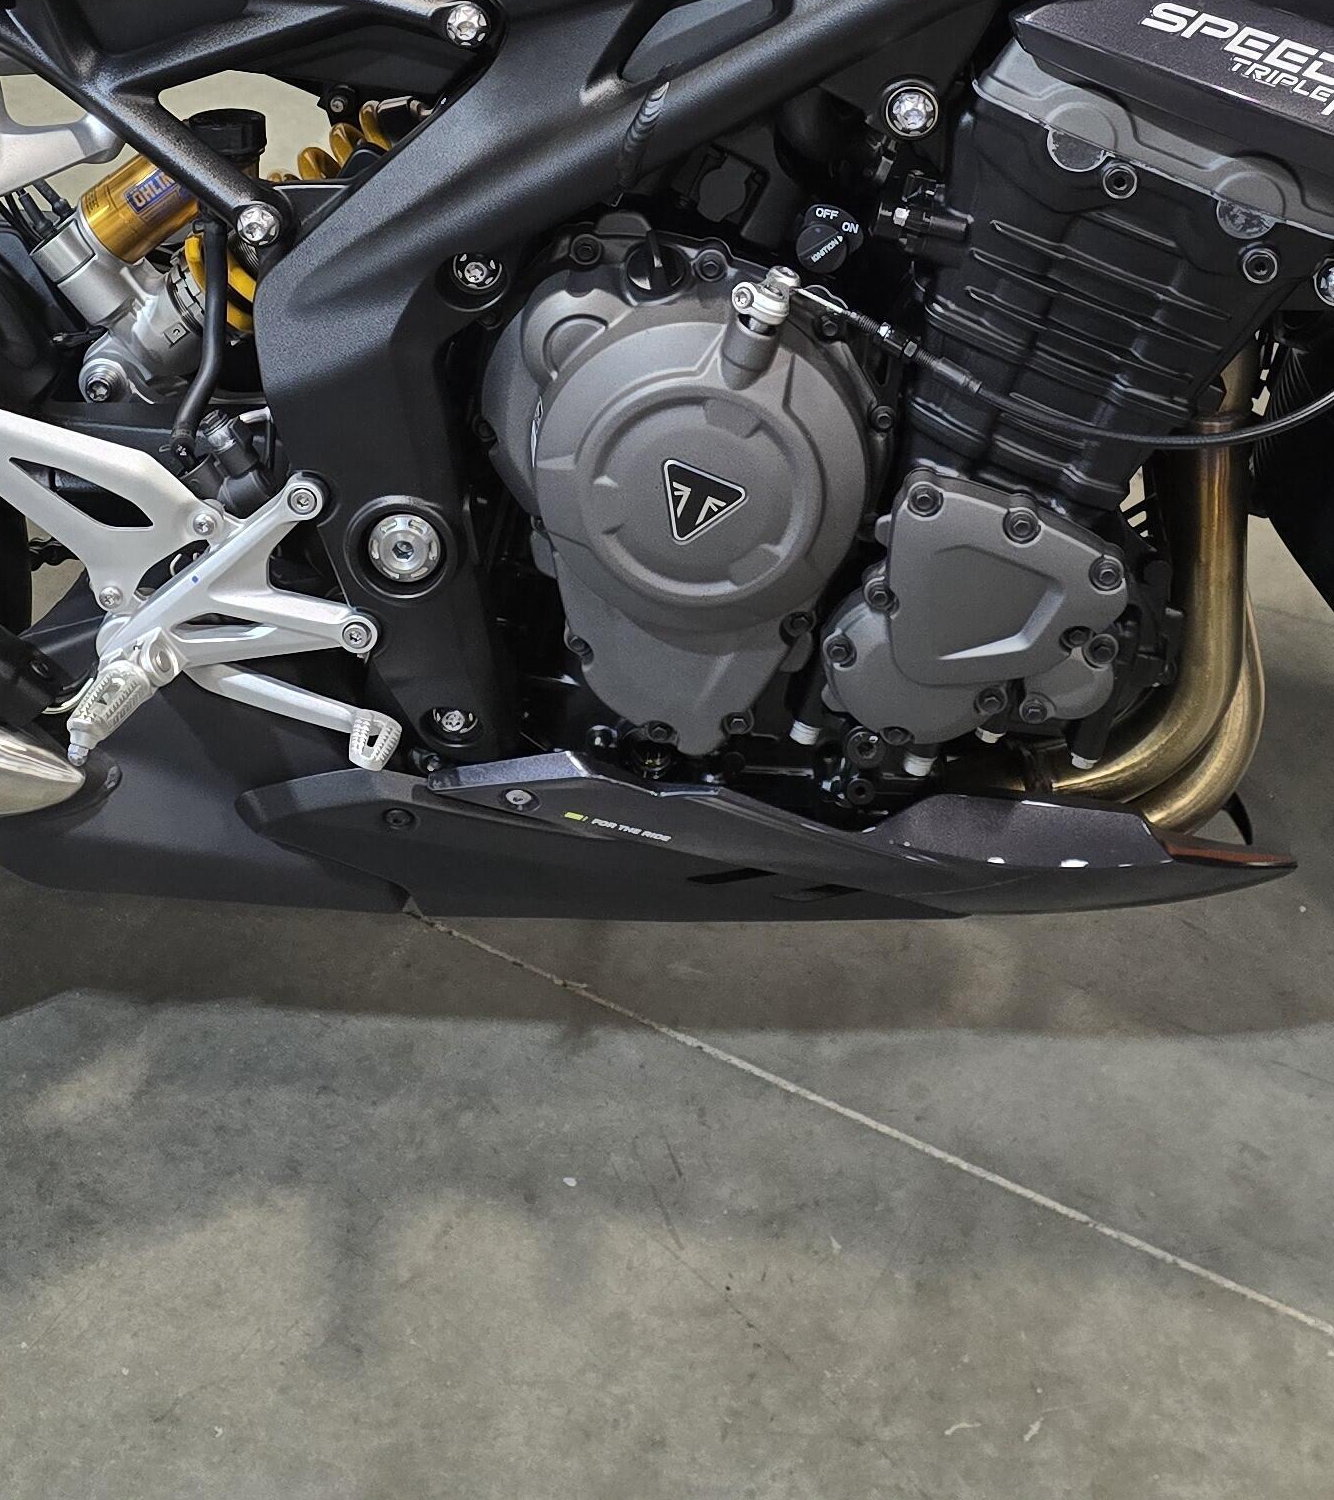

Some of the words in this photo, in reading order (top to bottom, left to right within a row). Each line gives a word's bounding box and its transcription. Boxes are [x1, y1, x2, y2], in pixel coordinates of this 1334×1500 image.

[129, 172, 175, 207] ÖHLIN
[815, 208, 839, 219] OFF
[842, 221, 859, 233] ON
[811, 238, 839, 262] IGNITION
[591, 819, 617, 828] FOR
[618, 824, 642, 834] THE
[641, 830, 671, 841] RIDE
